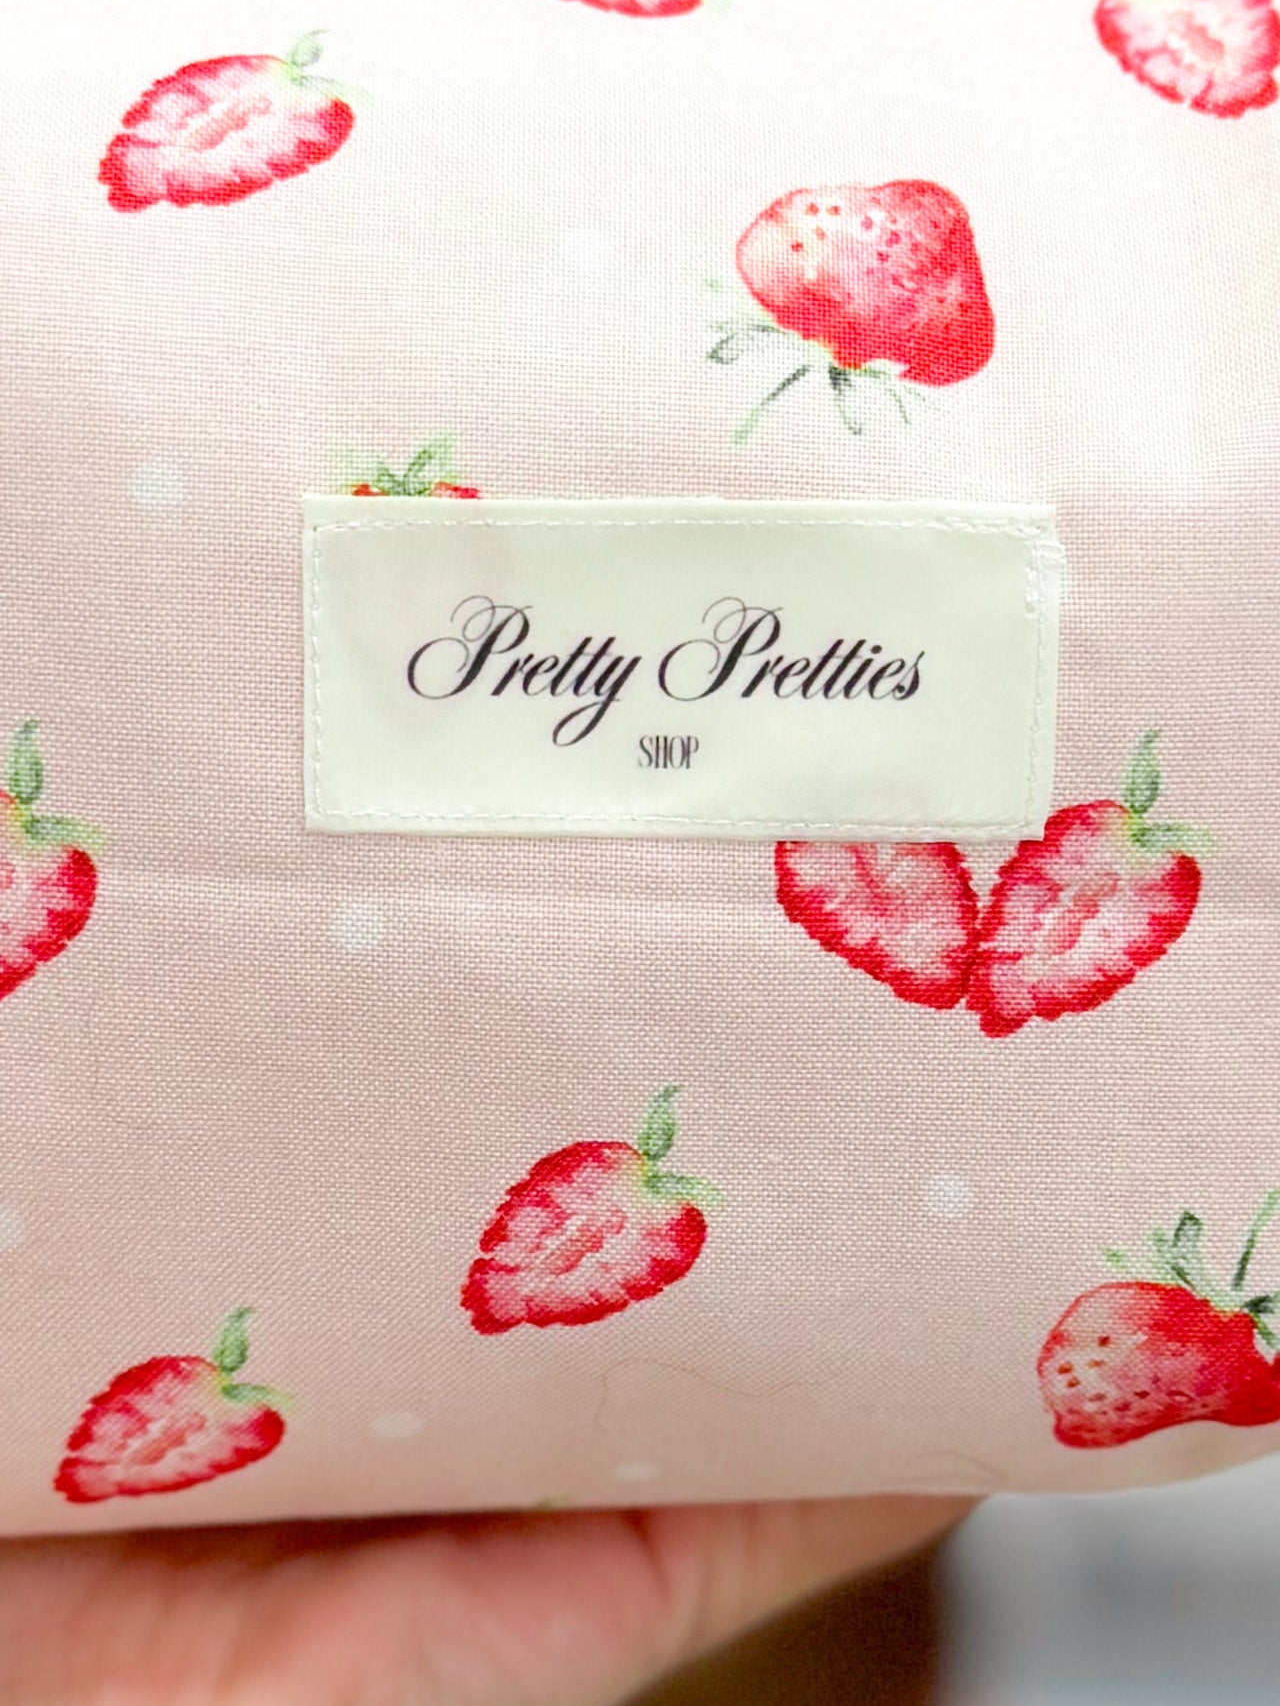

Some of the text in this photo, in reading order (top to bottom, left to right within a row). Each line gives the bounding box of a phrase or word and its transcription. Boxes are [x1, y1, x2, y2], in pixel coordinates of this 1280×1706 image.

[406, 595, 926, 747] Pretty Pretties
[637, 735, 700, 770] SHOP
